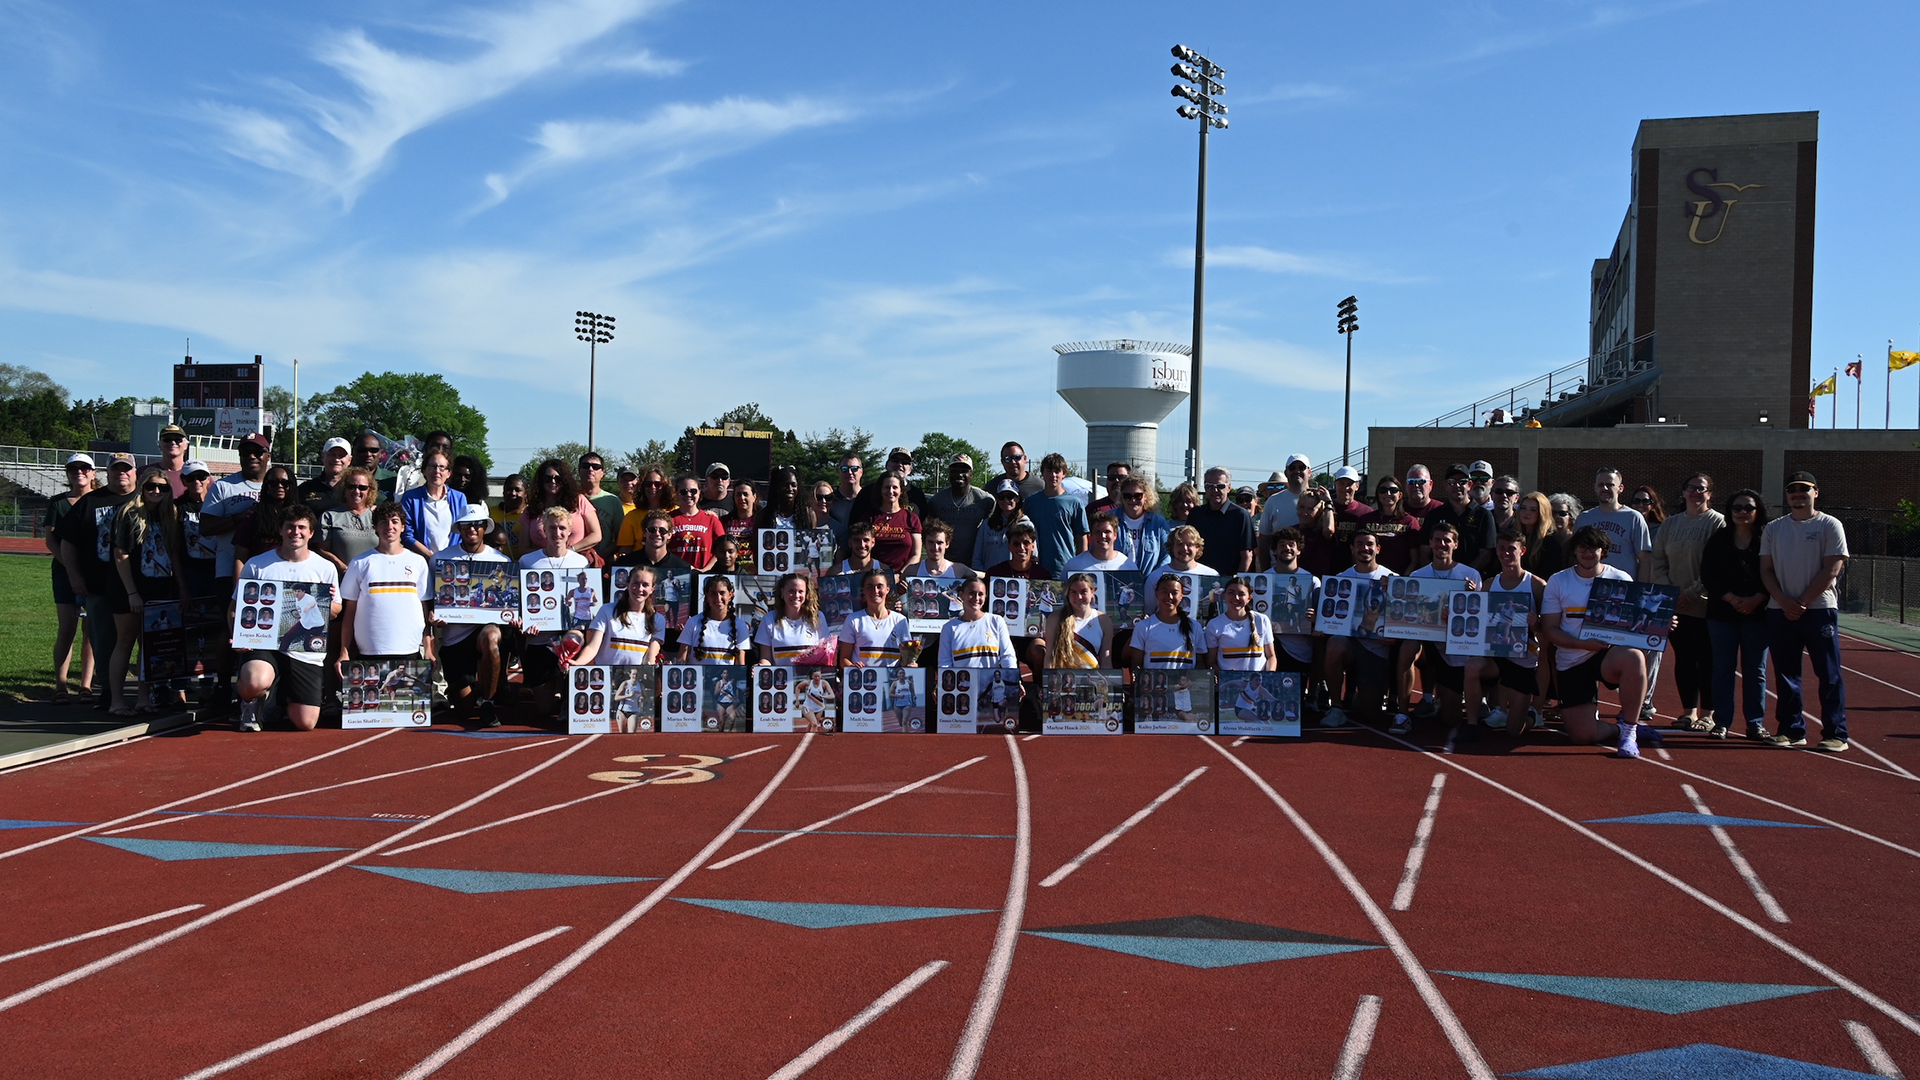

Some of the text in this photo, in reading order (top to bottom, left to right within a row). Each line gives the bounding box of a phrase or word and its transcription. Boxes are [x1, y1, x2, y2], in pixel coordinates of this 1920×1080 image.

[694, 427, 773, 439] SALISBURY UNIVERSITY
[587, 754, 728, 785] 3
